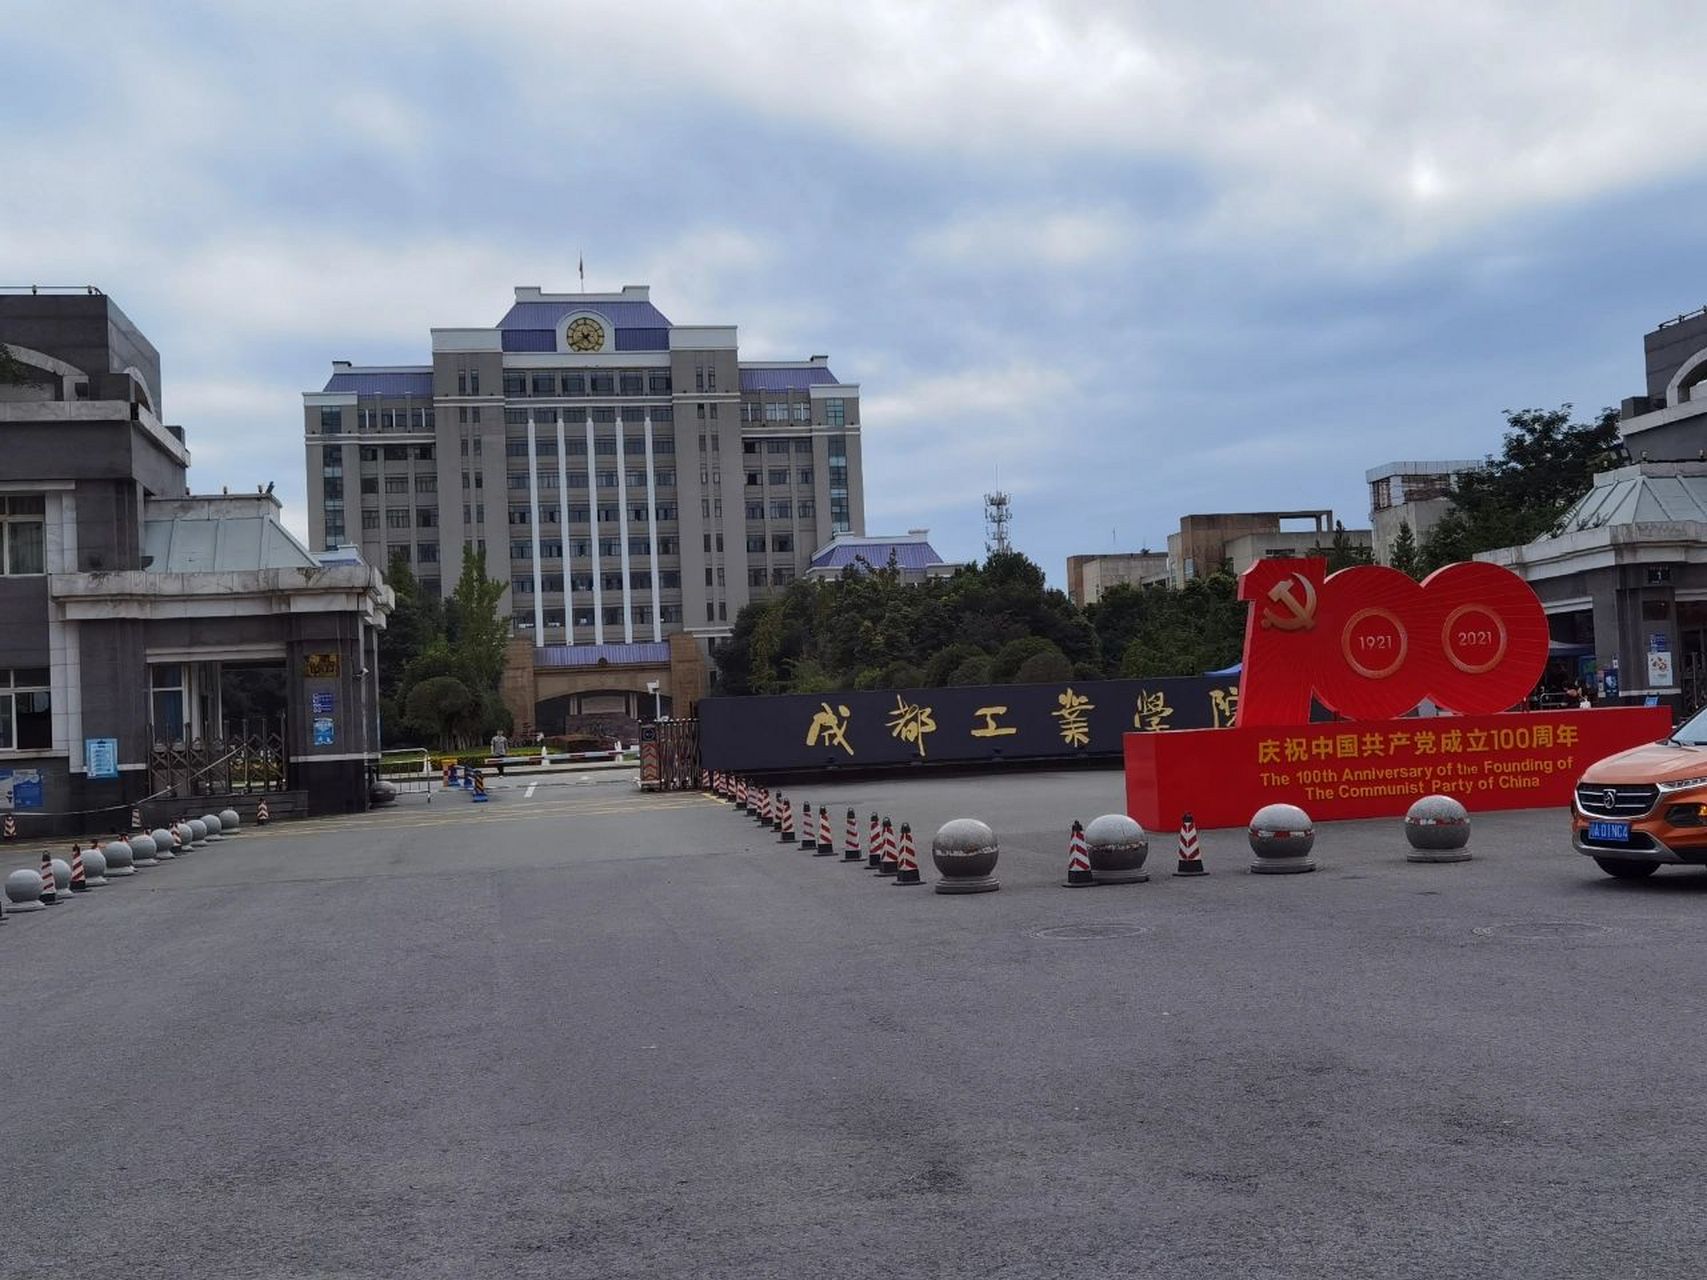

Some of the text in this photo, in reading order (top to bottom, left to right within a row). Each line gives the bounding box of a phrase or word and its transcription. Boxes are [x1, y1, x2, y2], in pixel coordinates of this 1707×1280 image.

[1358, 635, 1393, 650] 1921
[1458, 631, 1492, 646] 2021
[1258, 724, 1579, 764] 庆祝中国共产党成立100周年
[1260, 756, 1574, 787] The 100th Anniversary of the Founding of
[1305, 774, 1540, 801] The Communist Party of China
